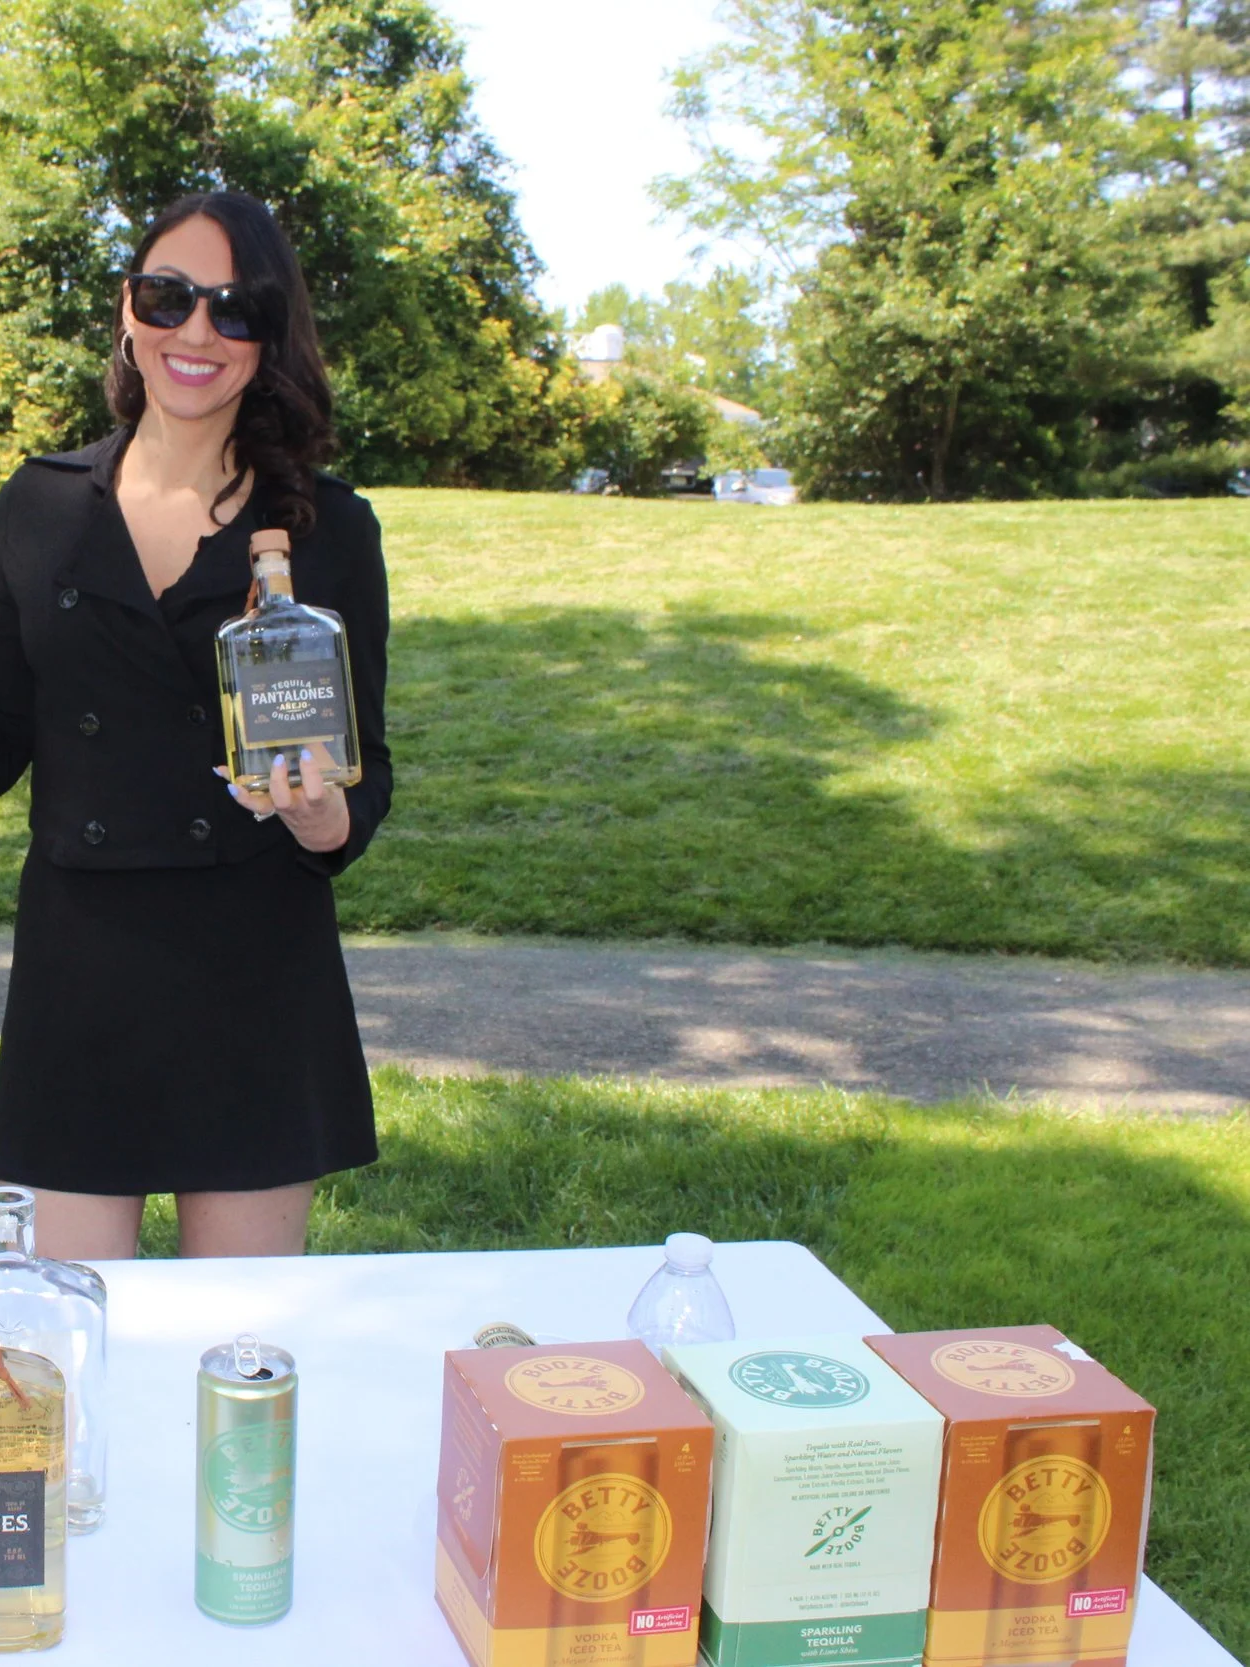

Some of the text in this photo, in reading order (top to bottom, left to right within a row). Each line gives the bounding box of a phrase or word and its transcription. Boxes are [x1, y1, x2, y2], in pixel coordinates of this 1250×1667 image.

[271, 680, 312, 691] TEQUILA
[251, 686, 334, 705] PANTALONES
[946, 1344, 1024, 1362] BOOZE
[521, 1360, 607, 1378] BOOZE
[742, 1362, 793, 1401] BETTY
[803, 1358, 858, 1398] BOOZE
[976, 1374, 1061, 1392] BETTY
[542, 1391, 628, 1409] BETTY
[1123, 1425, 1131, 1435] 4
[681, 1443, 691, 1453] 4
[783, 1454, 816, 1463] Sparkling
[837, 1450, 850, 1458] and
[850, 1449, 878, 1457] Natural
[878, 1447, 903, 1455] Flavors
[806, 1443, 830, 1452] Tequila
[1006, 1468, 1092, 1503] BETTY
[562, 1486, 651, 1521] BETTY
[812, 1506, 853, 1536] BETTY
[824, 1524, 865, 1555] BOOZE
[999, 1536, 1088, 1573] BOOZE
[557, 1554, 647, 1590] BOOZE
[1073, 1595, 1120, 1612] NO Artificial
[1092, 1602, 1119, 1610] Anything
[636, 1613, 685, 1629] NO Artificial
[655, 1621, 683, 1629] Anything
[1014, 1615, 1056, 1625] VODKA
[575, 1632, 618, 1643] VODKA
[800, 1624, 863, 1638] SPARKLING
[1008, 1626, 1060, 1637] ICED TEA
[569, 1644, 623, 1655] ICED TEA
[806, 1636, 855, 1648] TEQUILA
[800, 1650, 818, 1658] with
[818, 1648, 839, 1656] Lime
